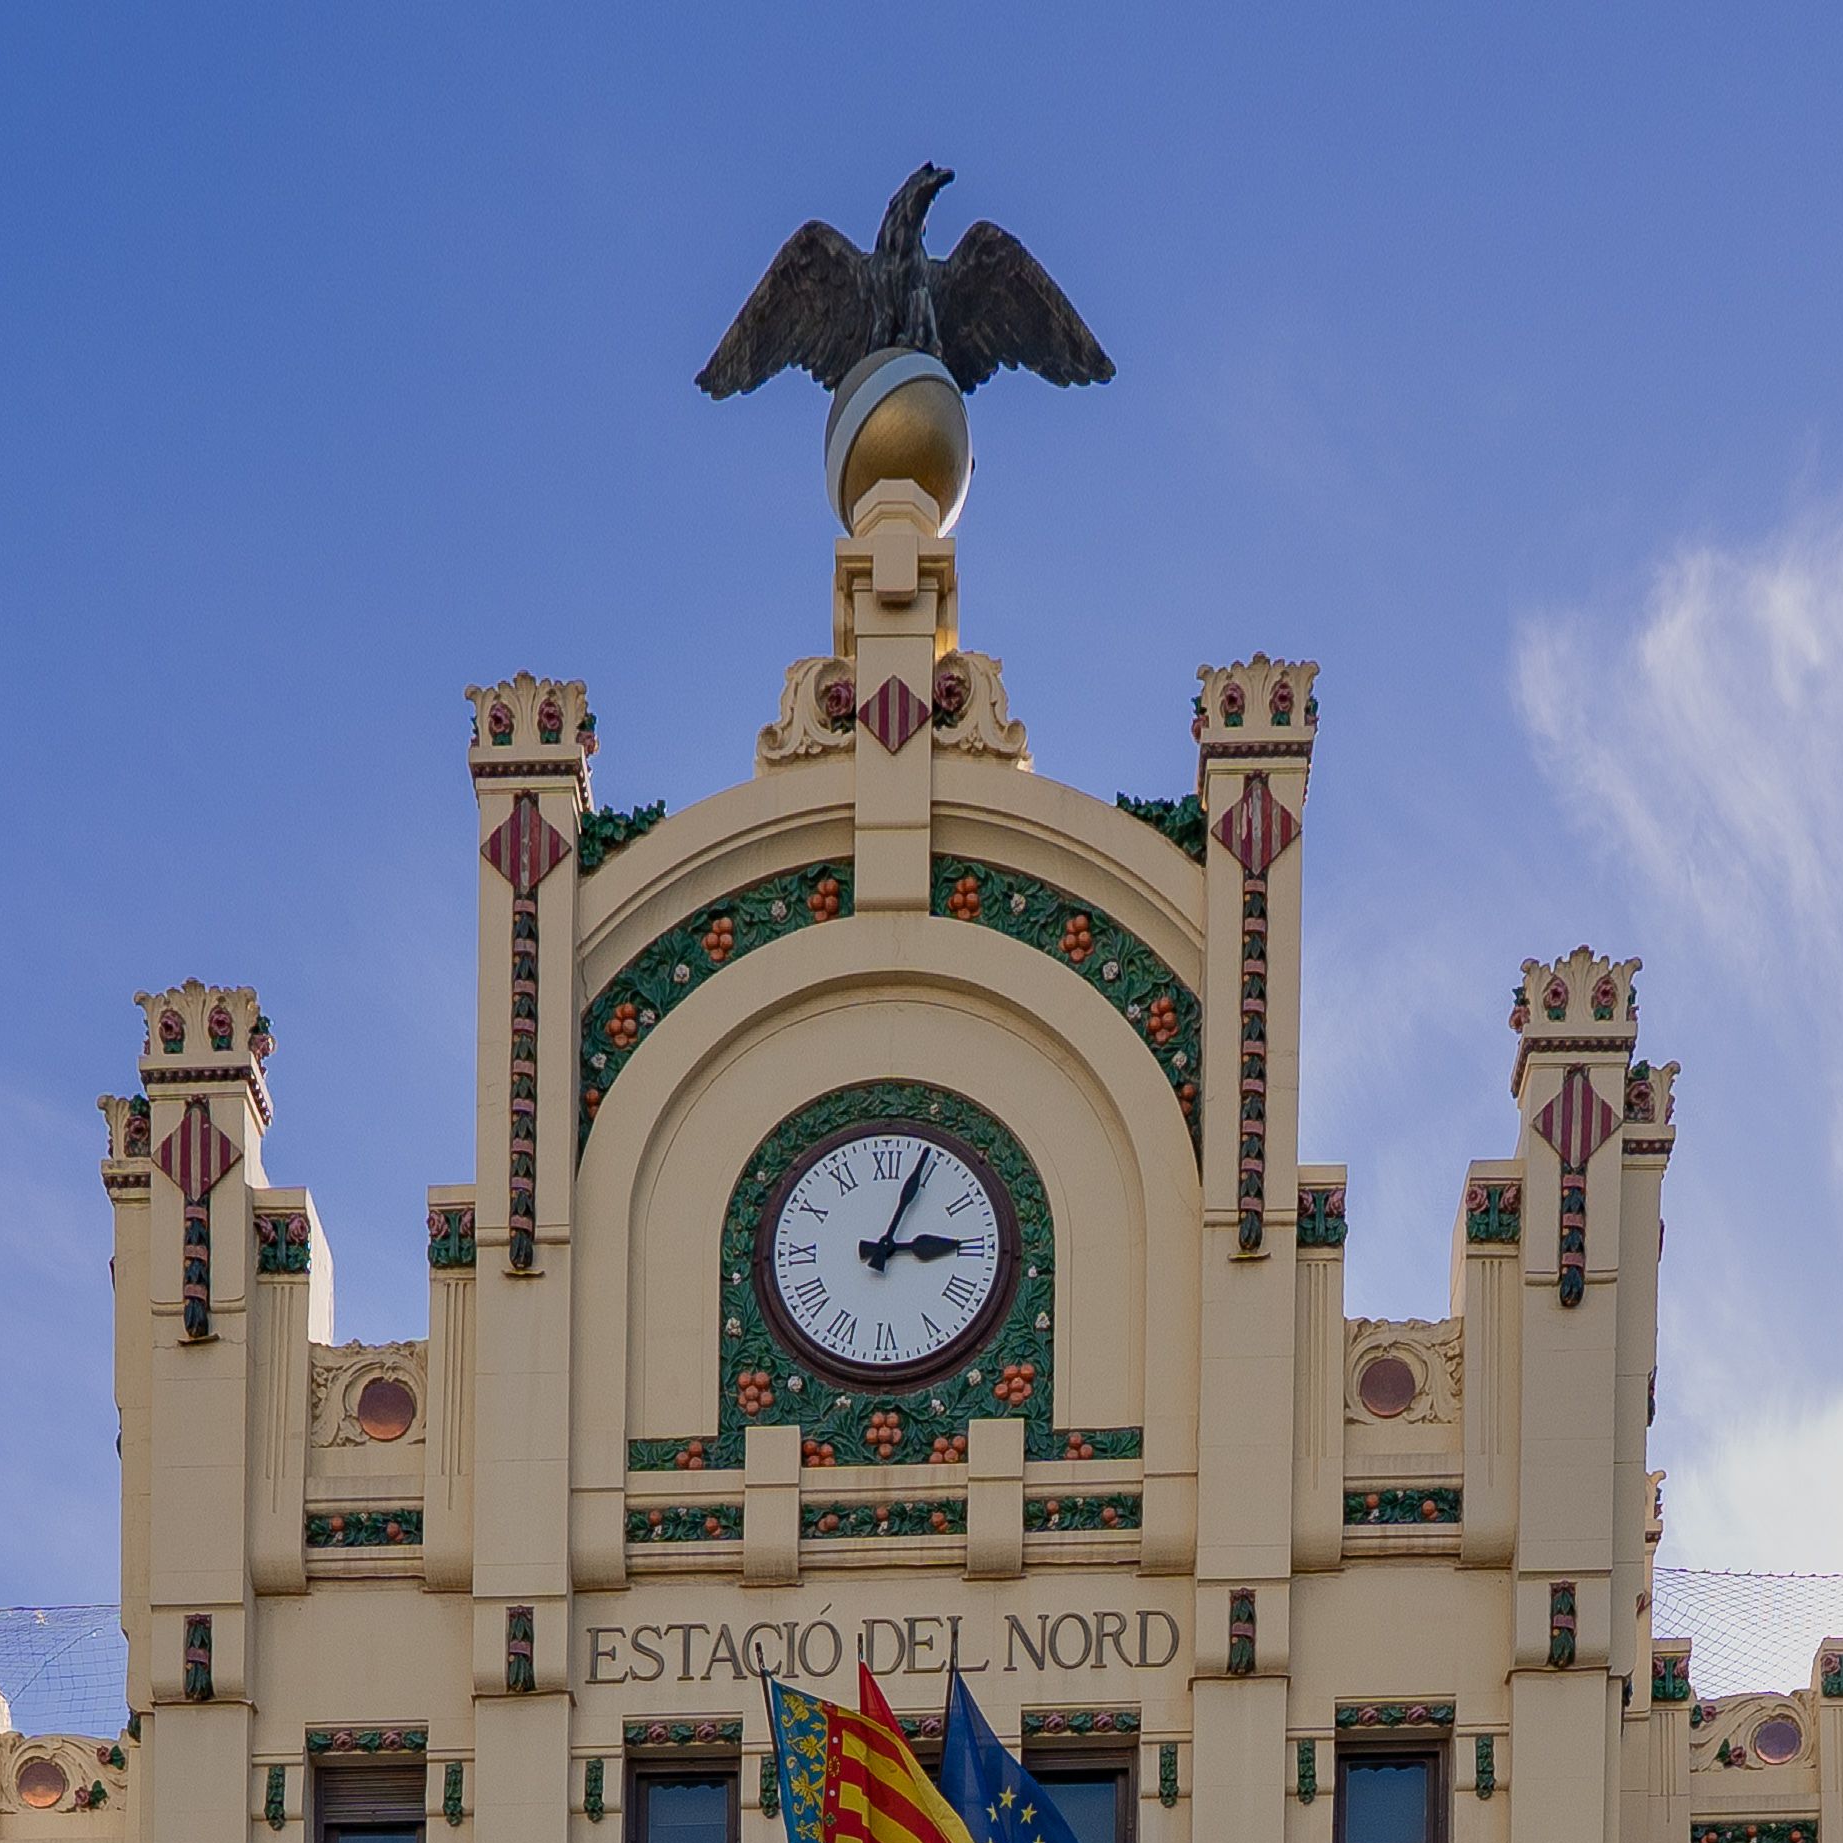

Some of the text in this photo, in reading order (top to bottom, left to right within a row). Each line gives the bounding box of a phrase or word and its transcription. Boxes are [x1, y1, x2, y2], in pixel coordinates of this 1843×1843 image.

[828, 1163, 858, 1196] XI
[873, 1151, 902, 1180] XII
[921, 1161, 938, 1188] I
[800, 1198, 828, 1223] X
[945, 1192, 974, 1217] II
[788, 1243, 816, 1266] IX
[958, 1236, 984, 1257] III
[795, 1277, 830, 1319] VIII
[942, 1274, 977, 1309] IIII
[827, 1309, 857, 1344] VII
[875, 1322, 897, 1350] VI
[920, 1312, 941, 1338] V
[585, 1603, 1180, 1684] ESTACIÓ DEL NORD
